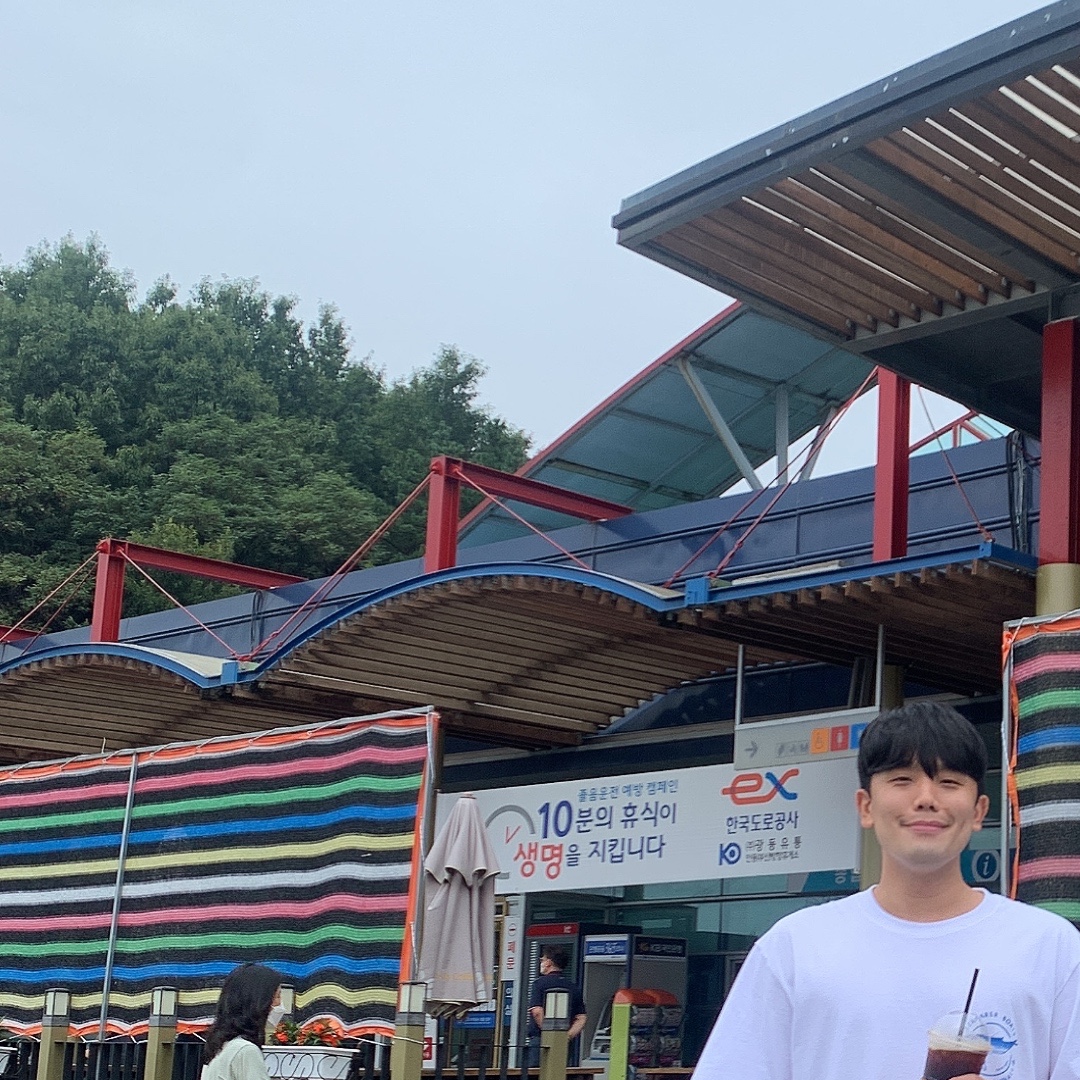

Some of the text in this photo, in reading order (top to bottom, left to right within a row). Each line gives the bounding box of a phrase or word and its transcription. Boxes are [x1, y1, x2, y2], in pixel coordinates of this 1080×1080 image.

[578, 779, 679, 802] 졸음운전 예방 캠페인
[722, 768, 799, 805] ex
[620, 801, 677, 829] 휴식이
[726, 811, 799, 834] 한국도로공사
[513, 835, 666, 879] 생명을 지킵니다
